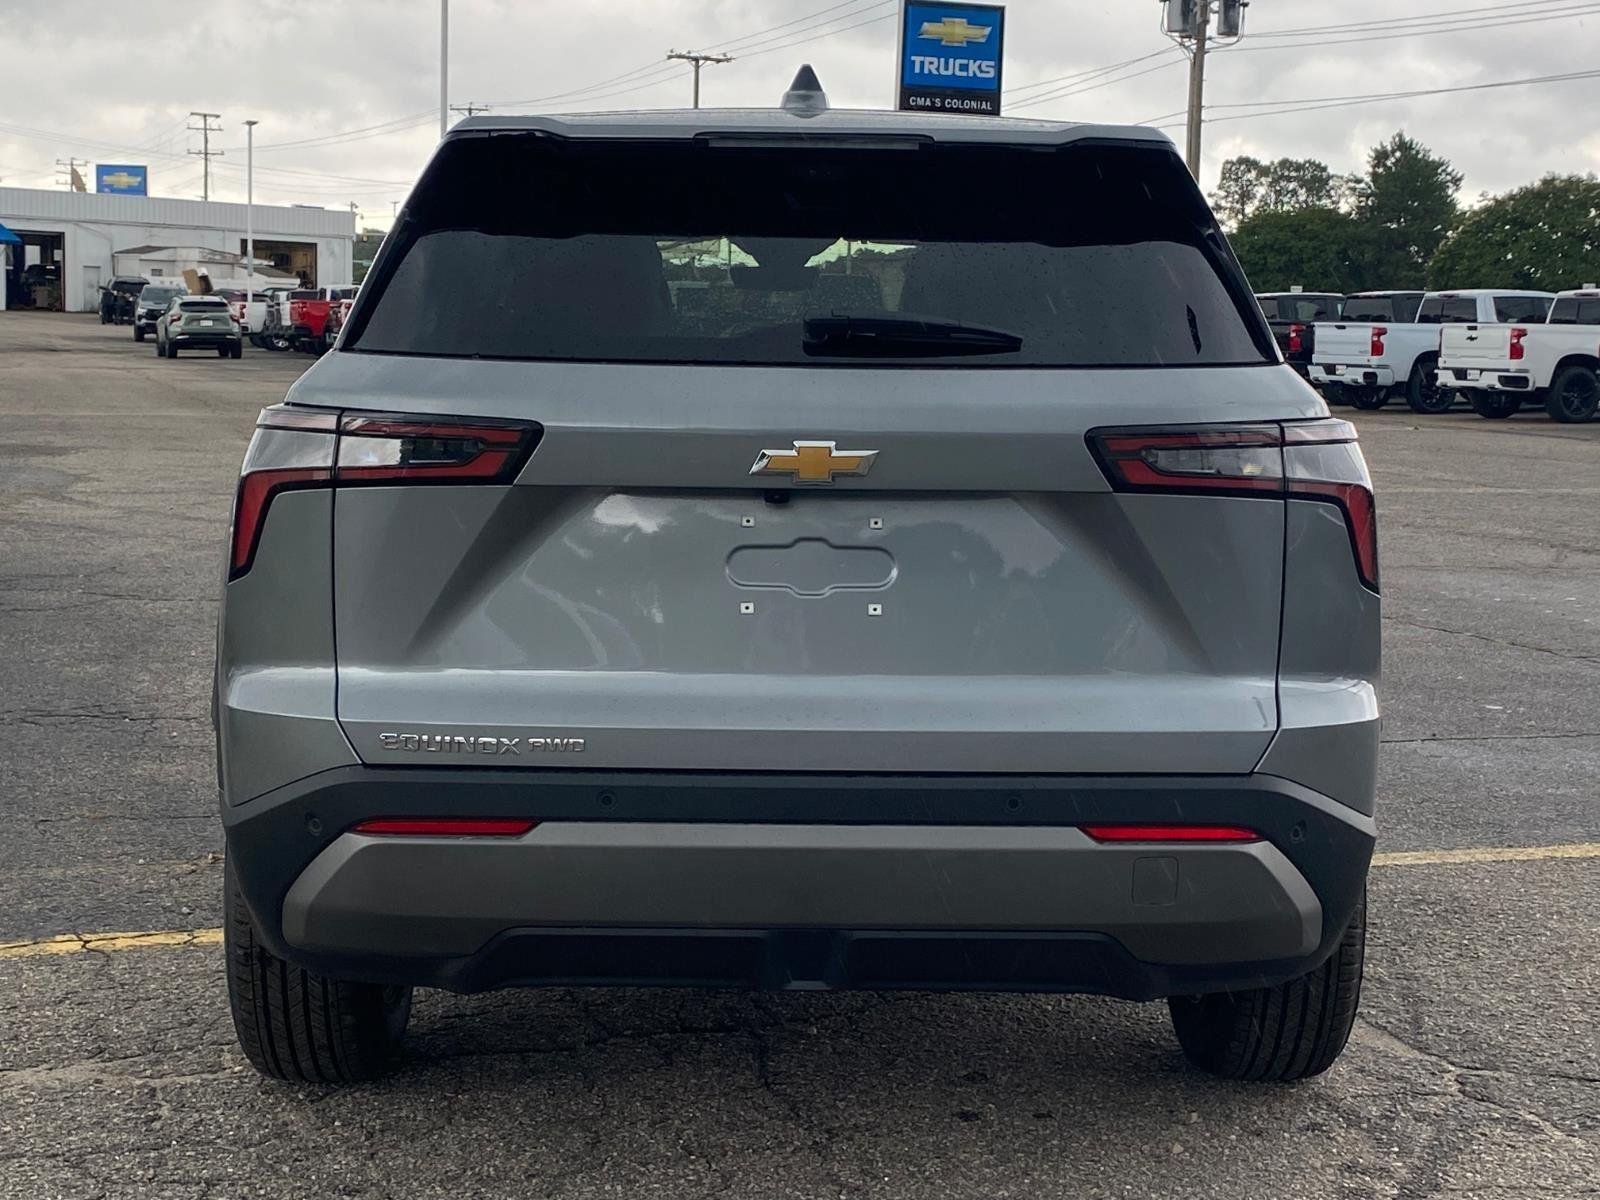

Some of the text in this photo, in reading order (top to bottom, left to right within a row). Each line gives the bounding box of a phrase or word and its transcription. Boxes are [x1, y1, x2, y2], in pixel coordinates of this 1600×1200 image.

[910, 55, 996, 79] TRUCKS
[909, 96, 993, 110] CMA'S COLONIAL
[379, 732, 521, 755] EQUINOX
